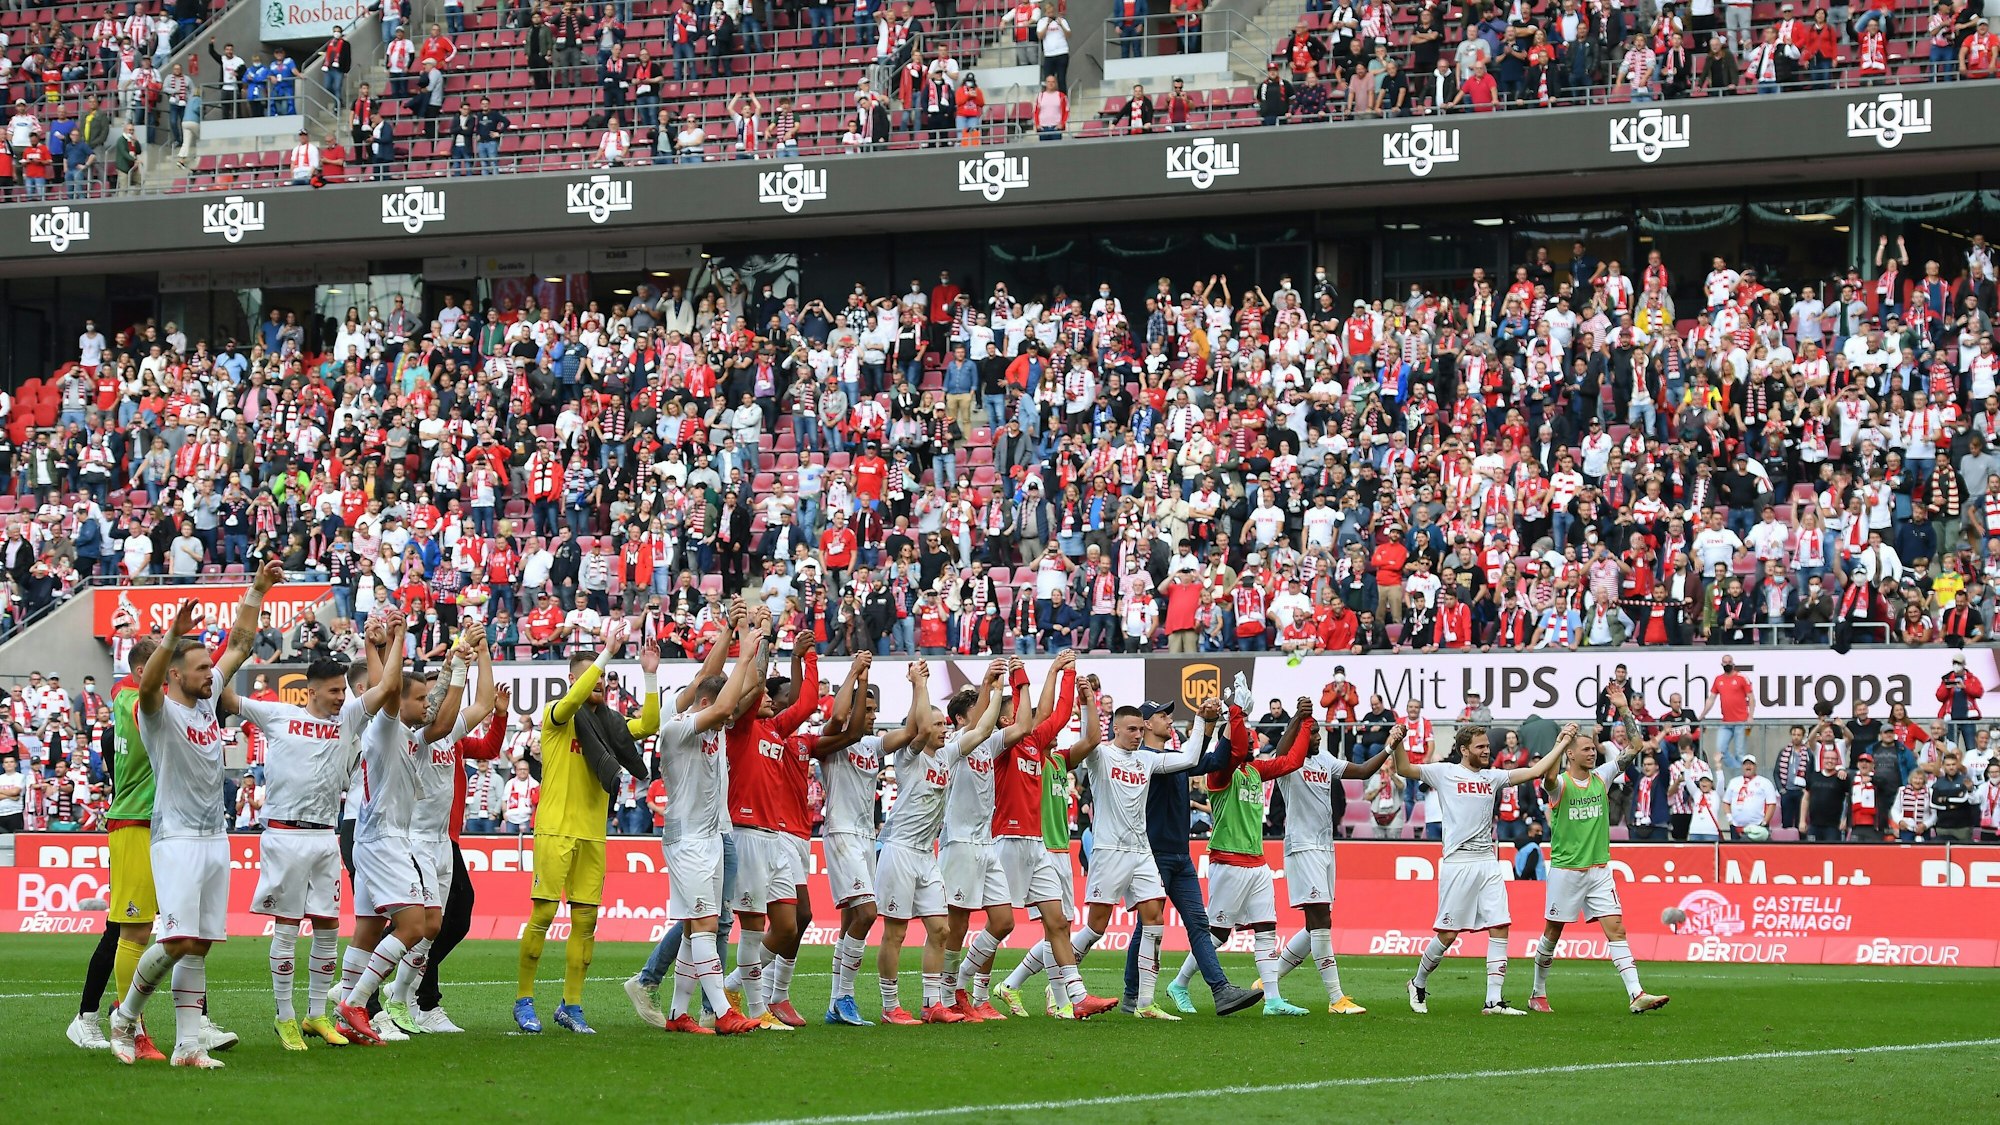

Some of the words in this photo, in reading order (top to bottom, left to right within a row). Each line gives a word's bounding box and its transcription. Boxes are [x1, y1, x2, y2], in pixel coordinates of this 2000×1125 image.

[288, 0, 371, 24] Rosbach
[1186, 679, 1217, 712] ups
[1374, 668, 1447, 710] Mit
[1462, 666, 1559, 709] UPS
[1575, 664, 1708, 708] drch
[1734, 664, 1912, 708] uropa
[288, 719, 340, 740] REWE
[1111, 766, 1148, 785] REWE
[1457, 782, 1493, 795] REWE
[1569, 804, 1603, 821] REWE
[1752, 896, 1841, 913] CASTELLI
[1752, 914, 1851, 931] FORMAGGI
